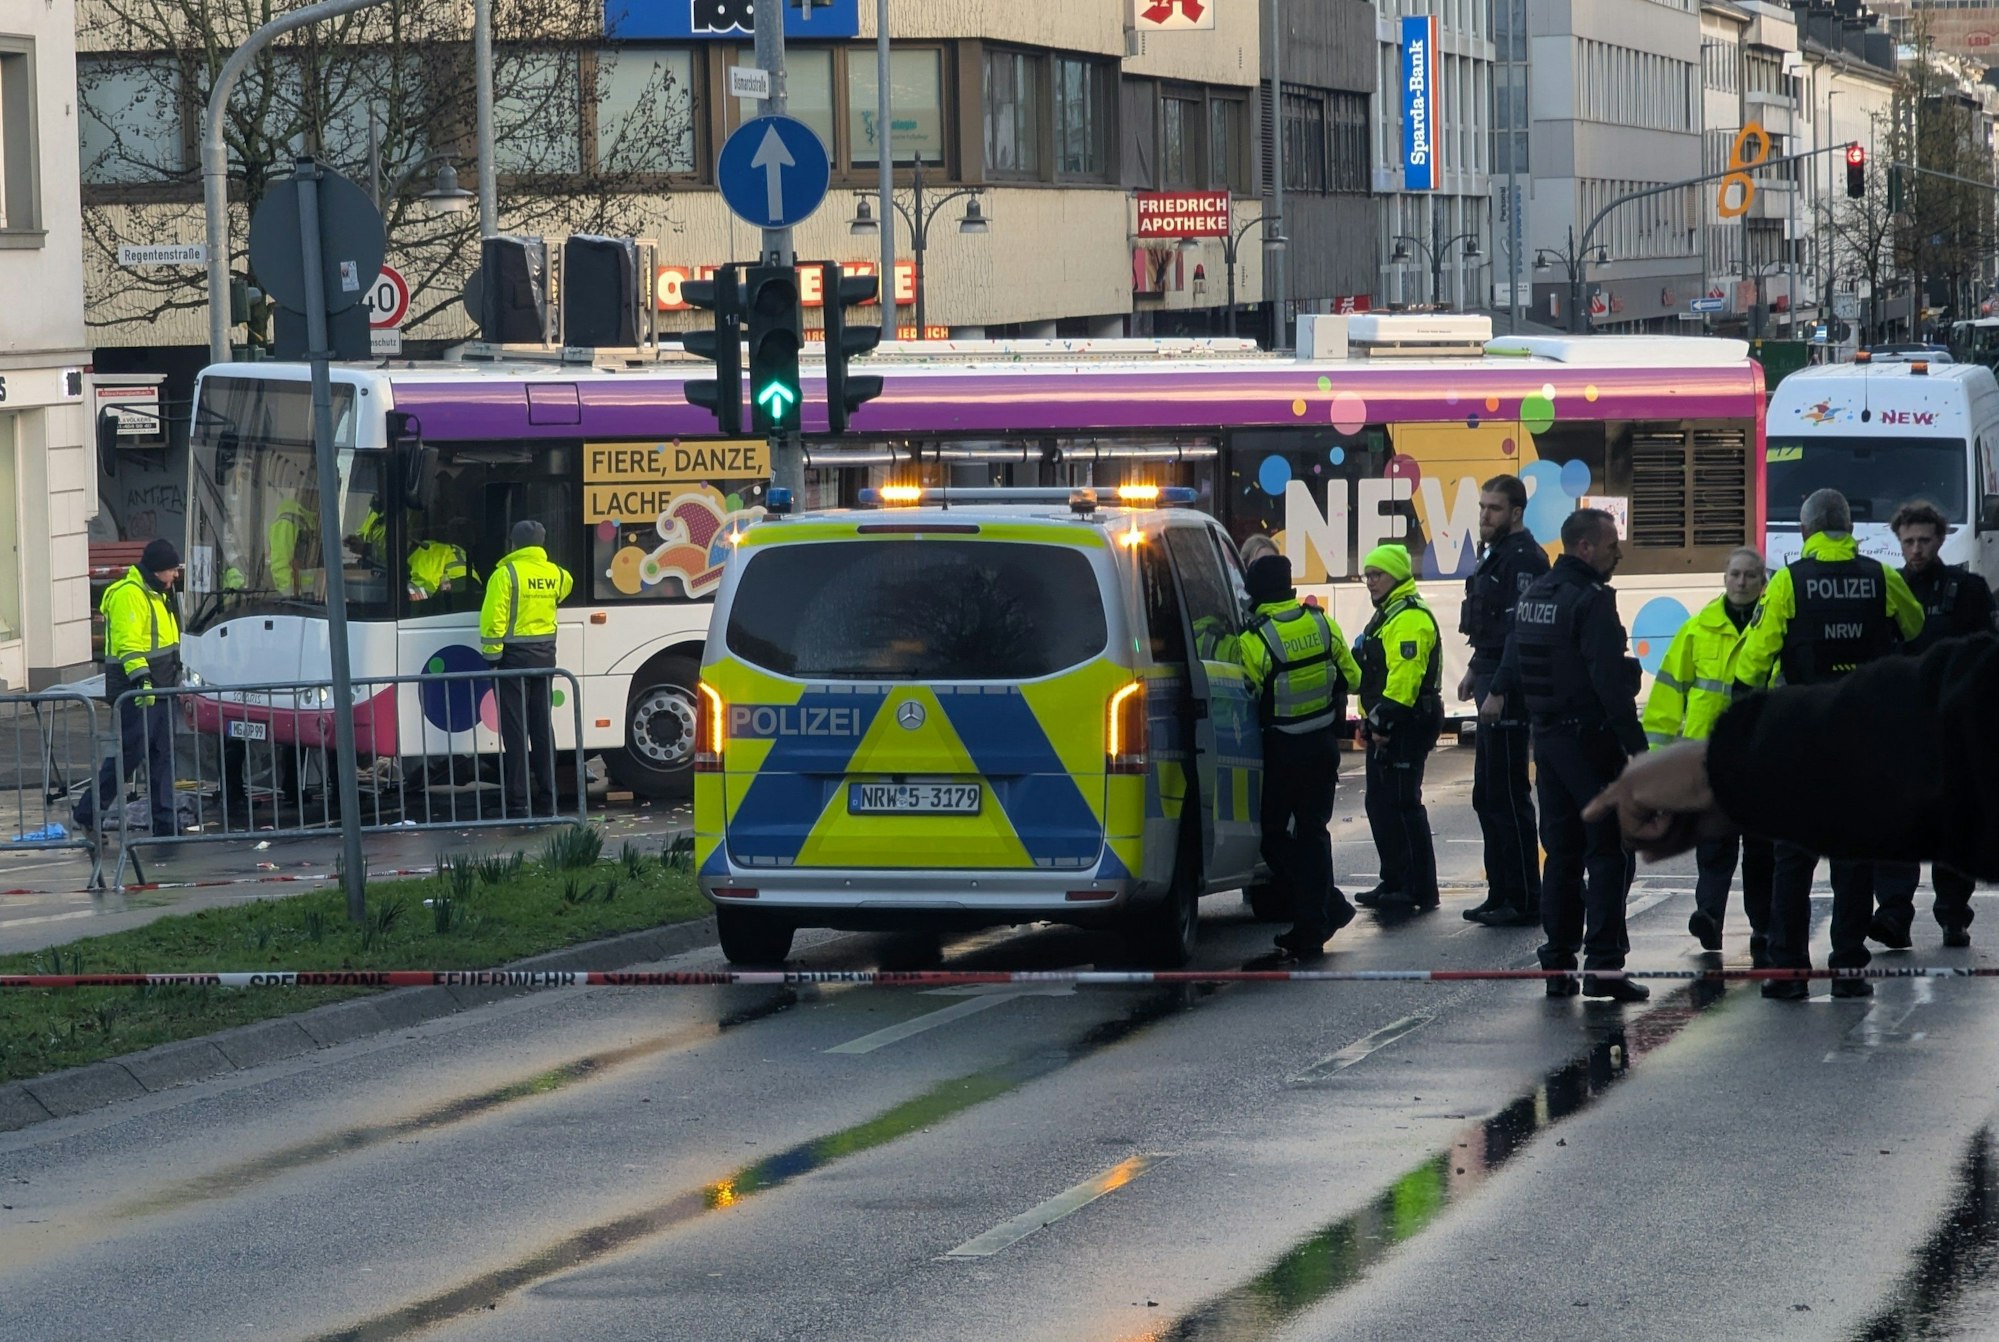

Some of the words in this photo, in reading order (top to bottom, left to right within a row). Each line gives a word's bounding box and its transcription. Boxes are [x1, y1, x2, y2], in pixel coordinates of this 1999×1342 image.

[1408, 39, 1429, 165] Sparda-Bank
[1139, 198, 1227, 213] FRIEDRICH
[1140, 216, 1227, 232] APOTHEKE
[124, 247, 200, 263] Regentenstraße
[1882, 410, 1934, 425] NEW
[592, 450, 667, 477] FIERE,
[675, 447, 763, 474] DANZE,
[528, 579, 556, 589] NEW
[1806, 578, 1876, 600] POLIZEI
[1517, 601, 1557, 624] POLIZEI
[1824, 623, 1863, 640] NRW
[1284, 632, 1324, 654] POLIZEI
[731, 707, 860, 736] POLIZEI
[861, 788, 897, 808] NRW
[908, 788, 978, 808] 5-3179
